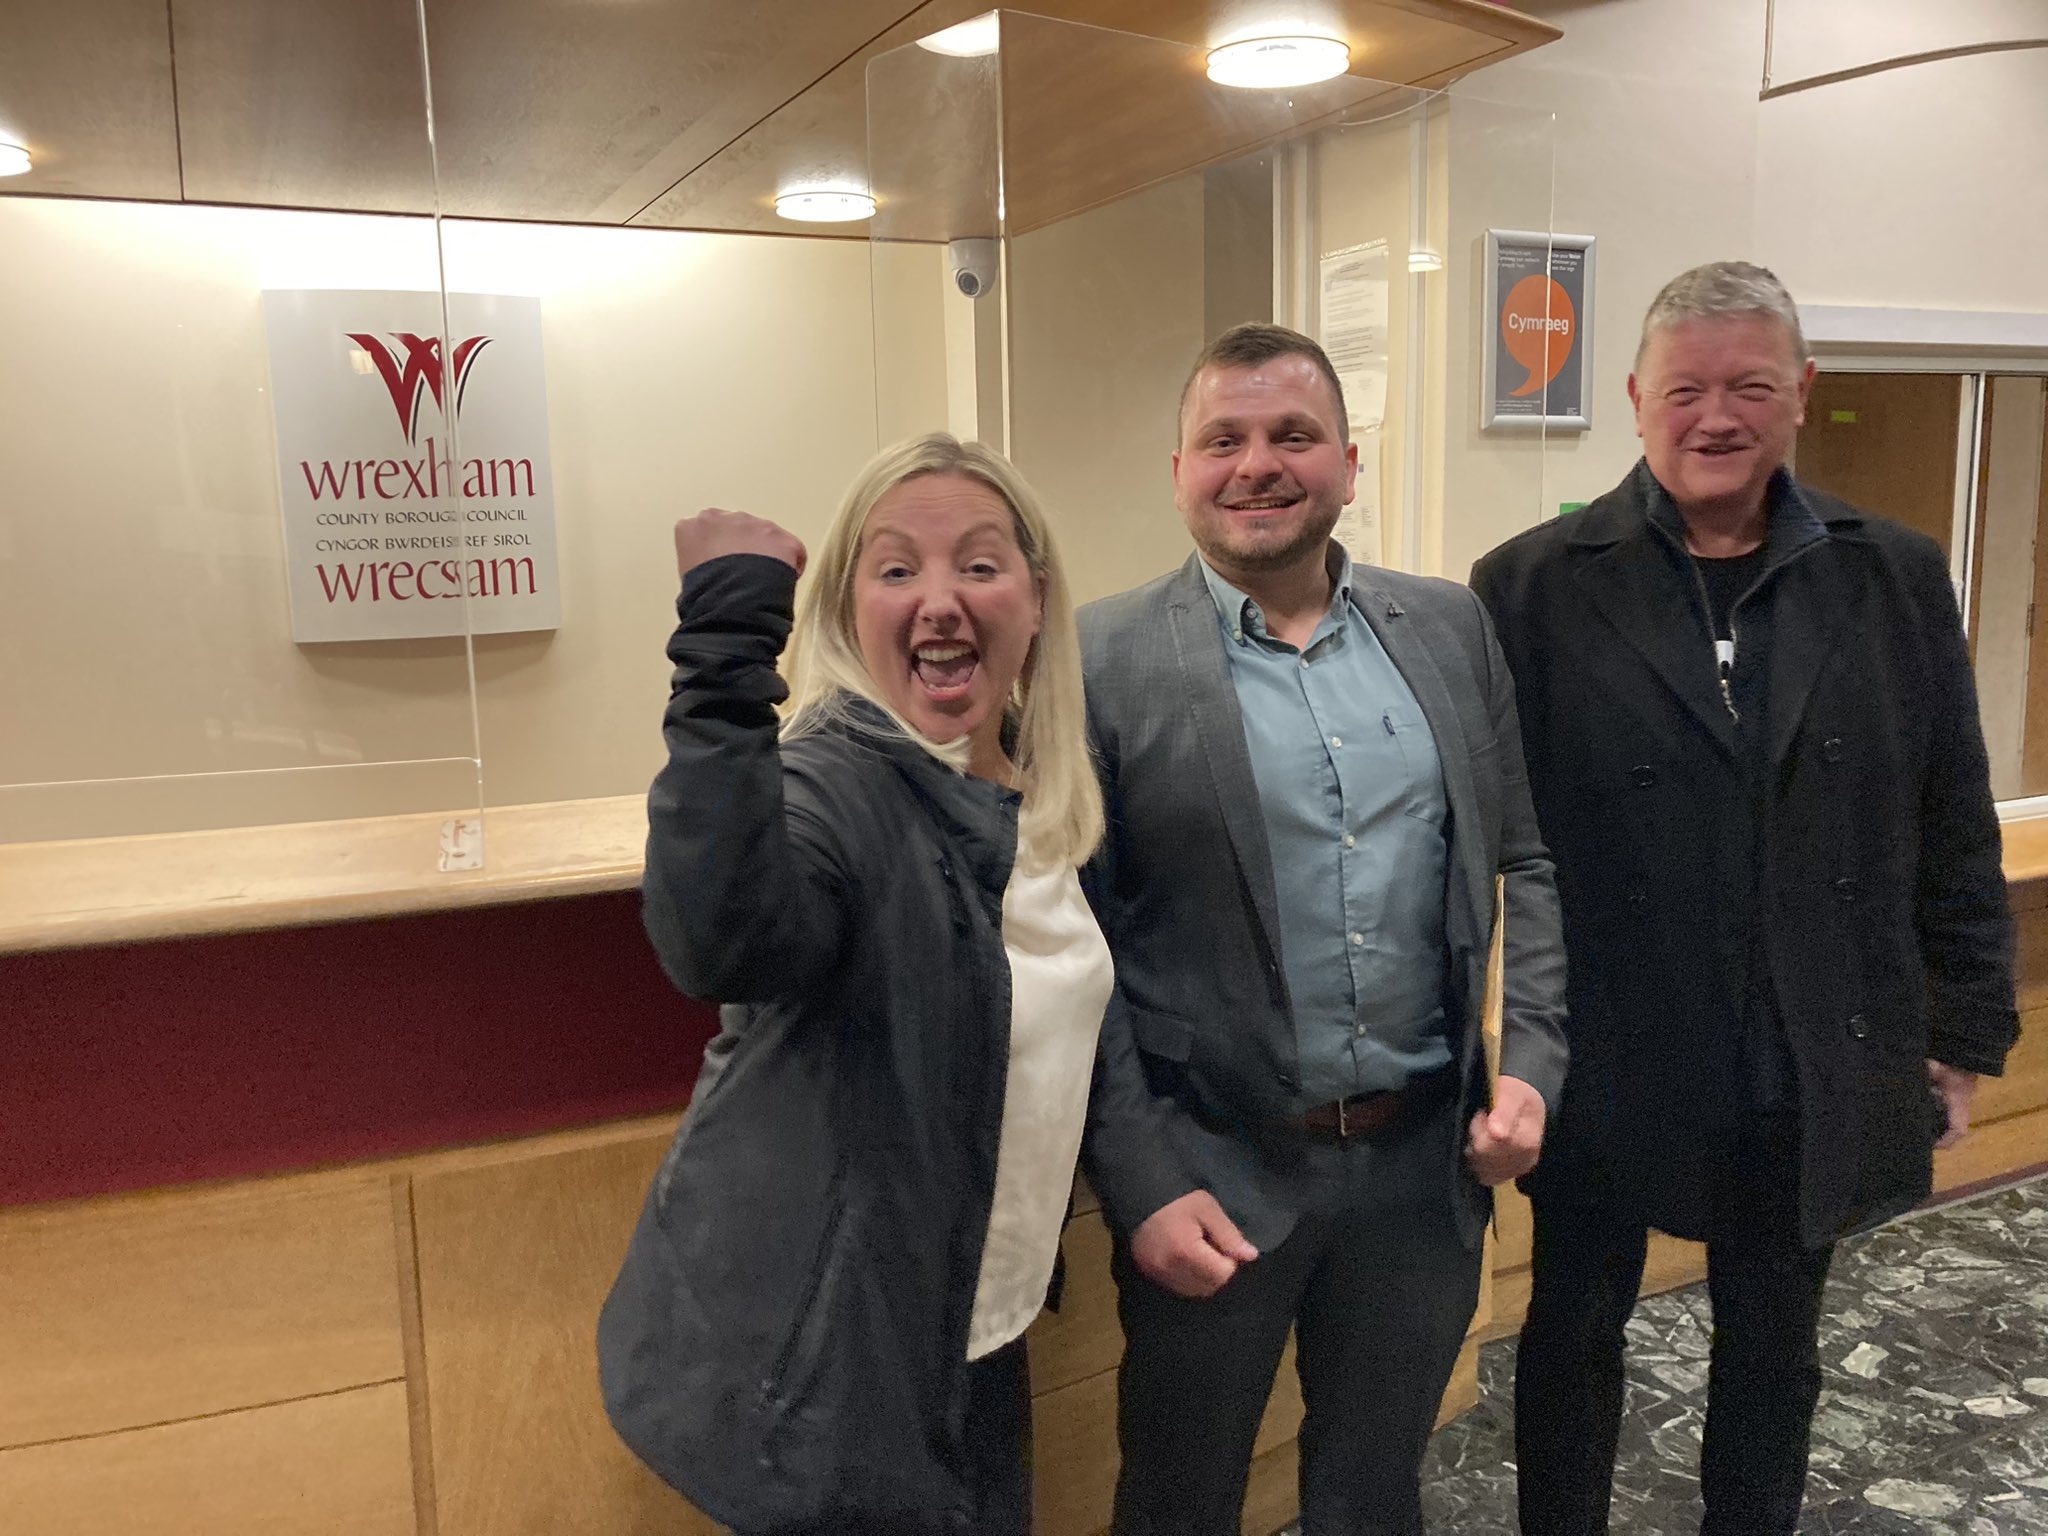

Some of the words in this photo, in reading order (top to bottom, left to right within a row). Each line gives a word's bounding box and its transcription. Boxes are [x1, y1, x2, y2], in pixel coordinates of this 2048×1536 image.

[1508, 312, 1569, 335] Cymraeg
[300, 436, 537, 501] wrexham
[316, 513, 380, 526] COUNTY
[467, 509, 528, 522] COUNCIL
[315, 538, 380, 552] CYNGOR
[385, 535, 489, 550] BWRDEISREF
[493, 533, 532, 546] SIROL
[313, 555, 539, 603] wrecsam
